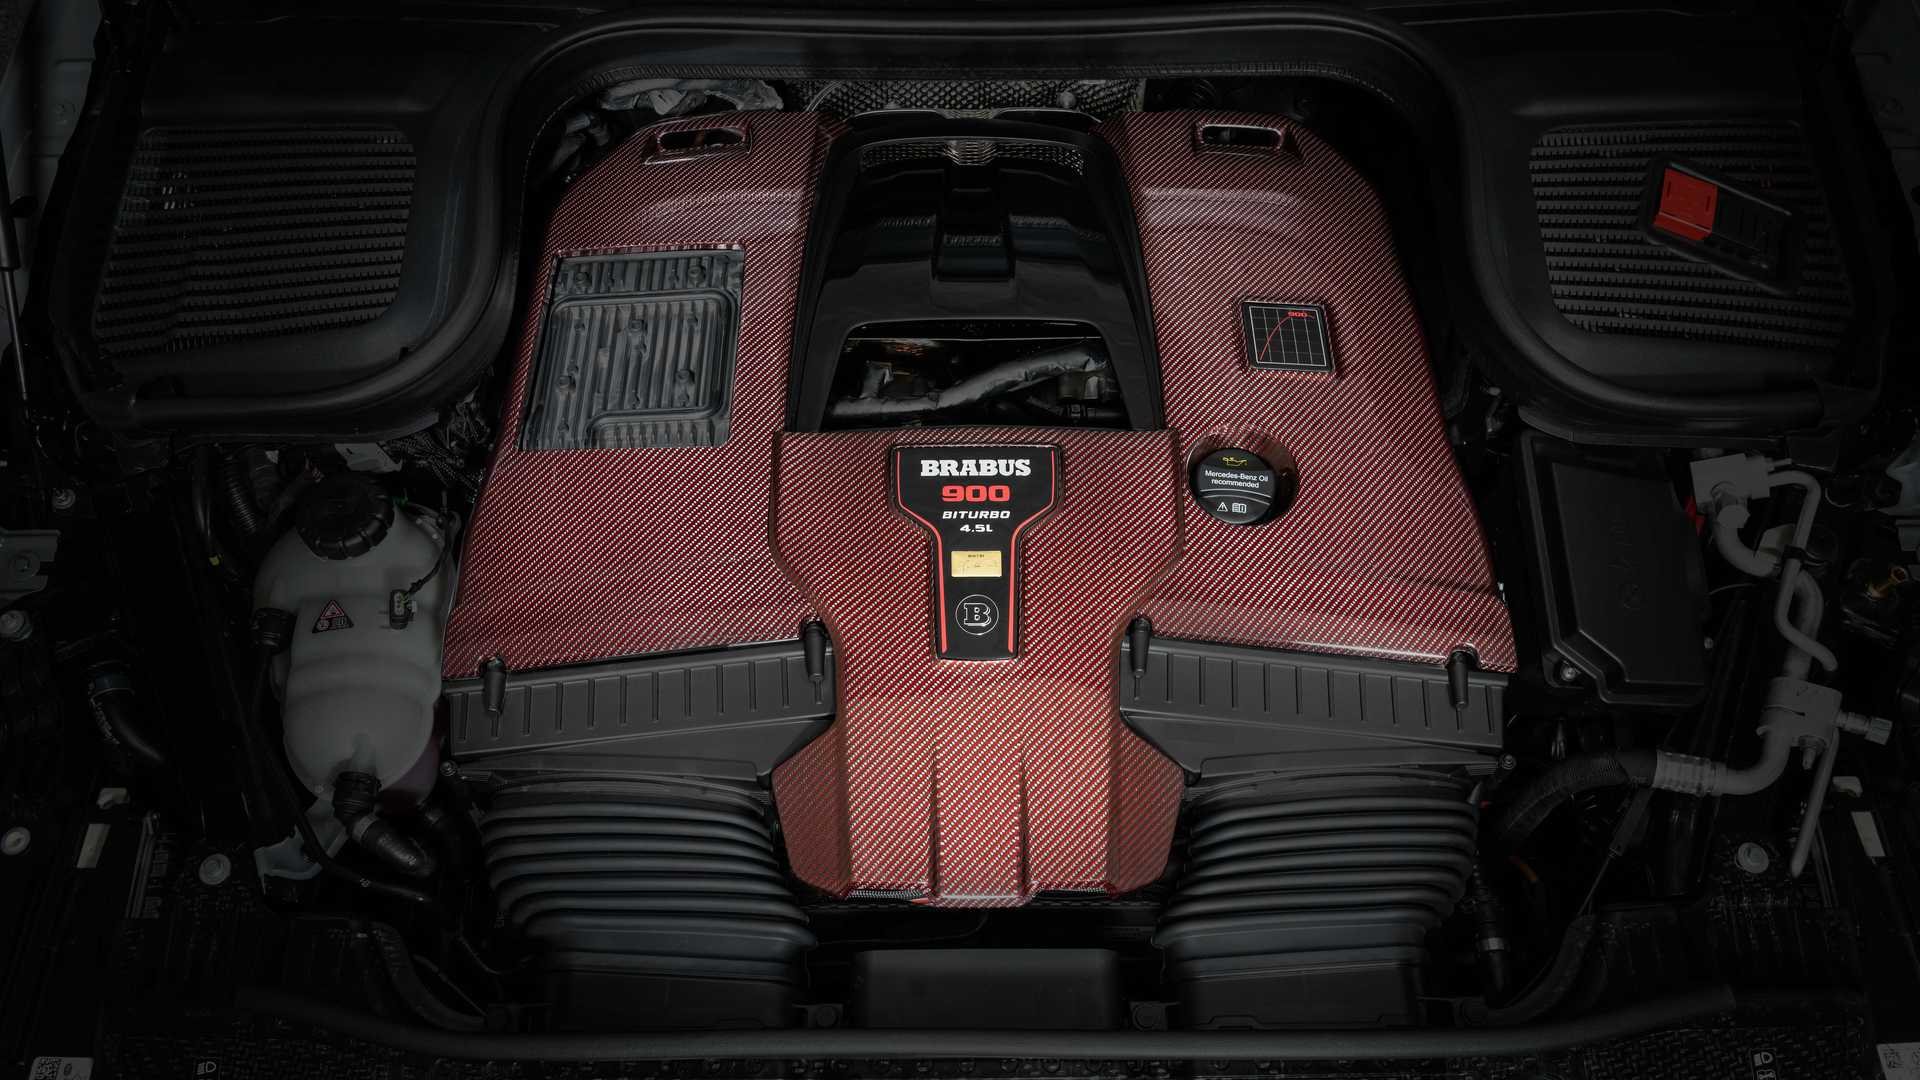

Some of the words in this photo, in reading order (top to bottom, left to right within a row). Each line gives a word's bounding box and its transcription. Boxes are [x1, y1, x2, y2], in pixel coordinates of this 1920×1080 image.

[920, 459, 1032, 477] BRABUS
[1204, 469, 1257, 481] Mercedes-Benz
[1258, 474, 1269, 483] Oil
[1211, 478, 1260, 489] recommended
[942, 485, 1011, 502] 900
[942, 510, 1011, 520] BITURBO
[959, 523, 993, 533] 4.5L
